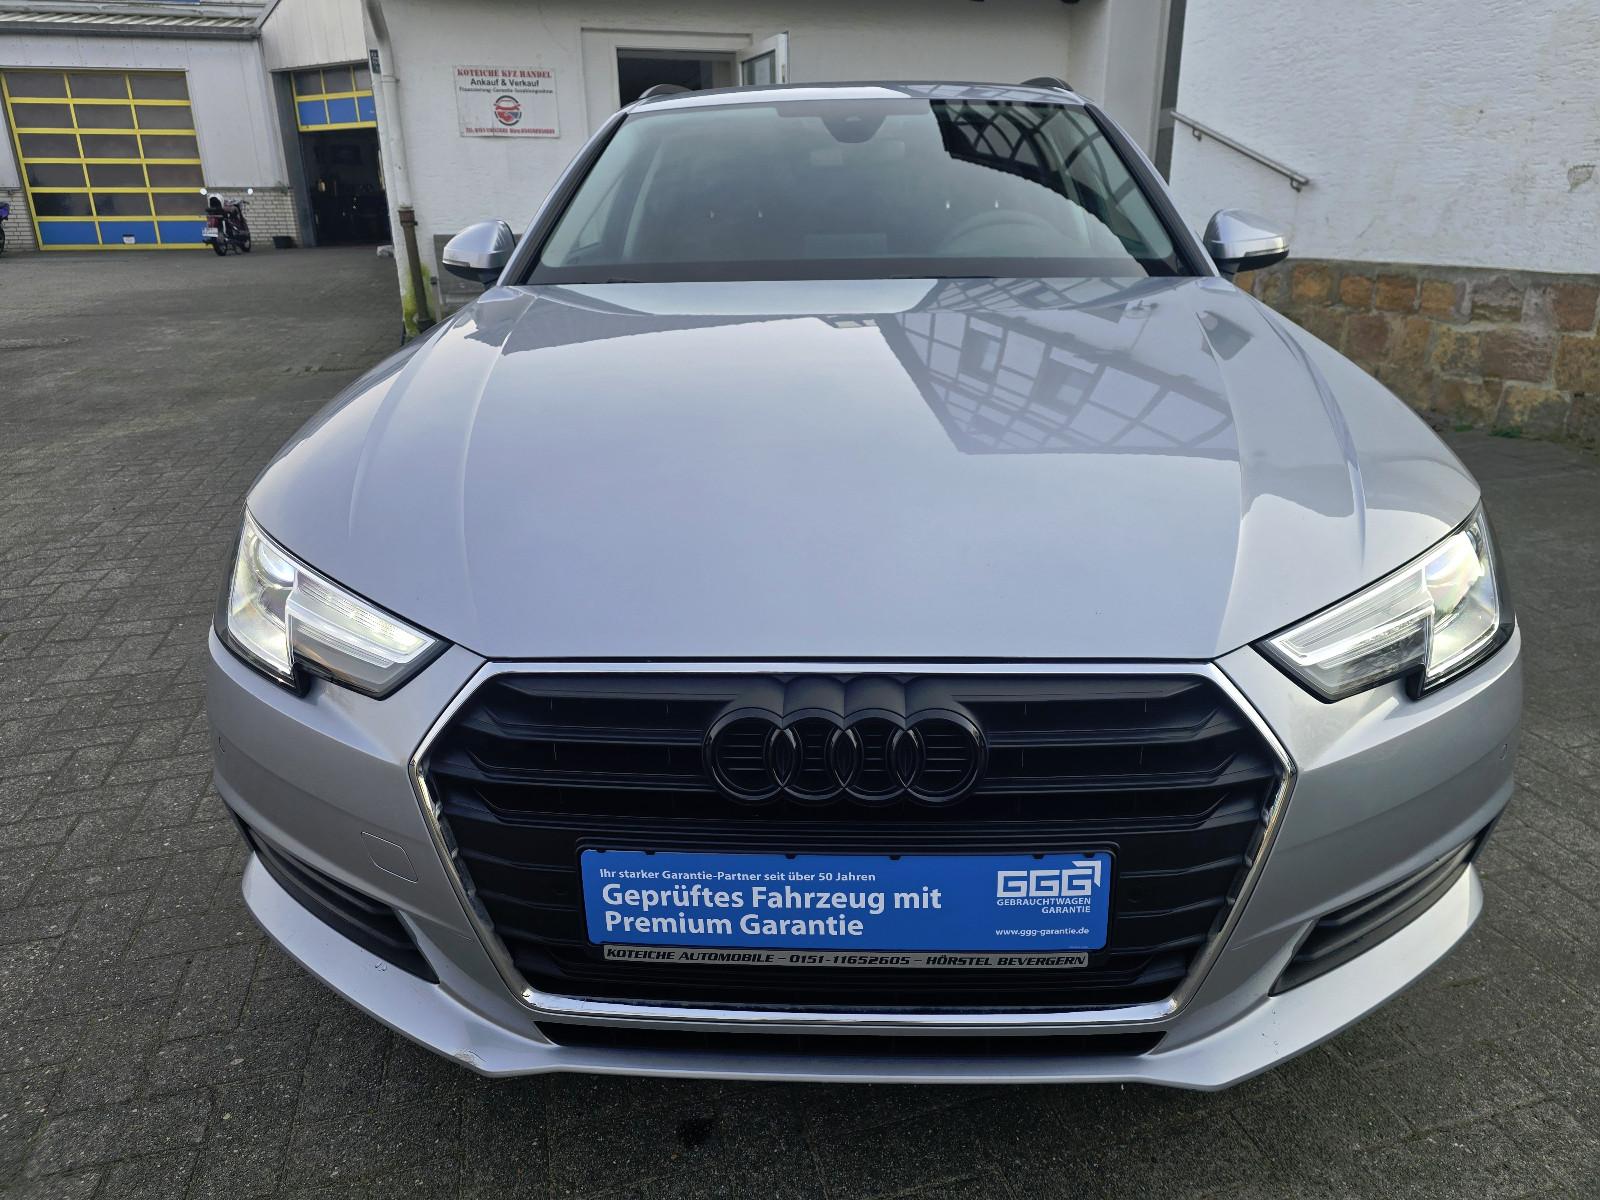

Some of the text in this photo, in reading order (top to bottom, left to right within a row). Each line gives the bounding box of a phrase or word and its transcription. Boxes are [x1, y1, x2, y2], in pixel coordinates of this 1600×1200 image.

[470, 78, 499, 87] Ankauf
[509, 79, 539, 87] Verkauf
[600, 868, 876, 882] Ihr starker Garantie-Partner seit über 50 Jahren
[997, 868, 1093, 898] GGG
[602, 883, 942, 915] Geprüftes Fahrzeug mit
[997, 897, 1091, 906] GEBRAUCHTWAGEN
[1041, 906, 1091, 914] GARANTIE
[605, 910, 864, 936] Premium Garantie
[995, 926, 1090, 937] www.ggg-garantie.de
[606, 948, 676, 960] KOTEICHE
[678, 950, 775, 963] AUTOMOBILE
[789, 953, 911, 966] 0151-11652605
[926, 953, 993, 966] HÖRSTEL
[997, 954, 1086, 967] BEVERGERN
